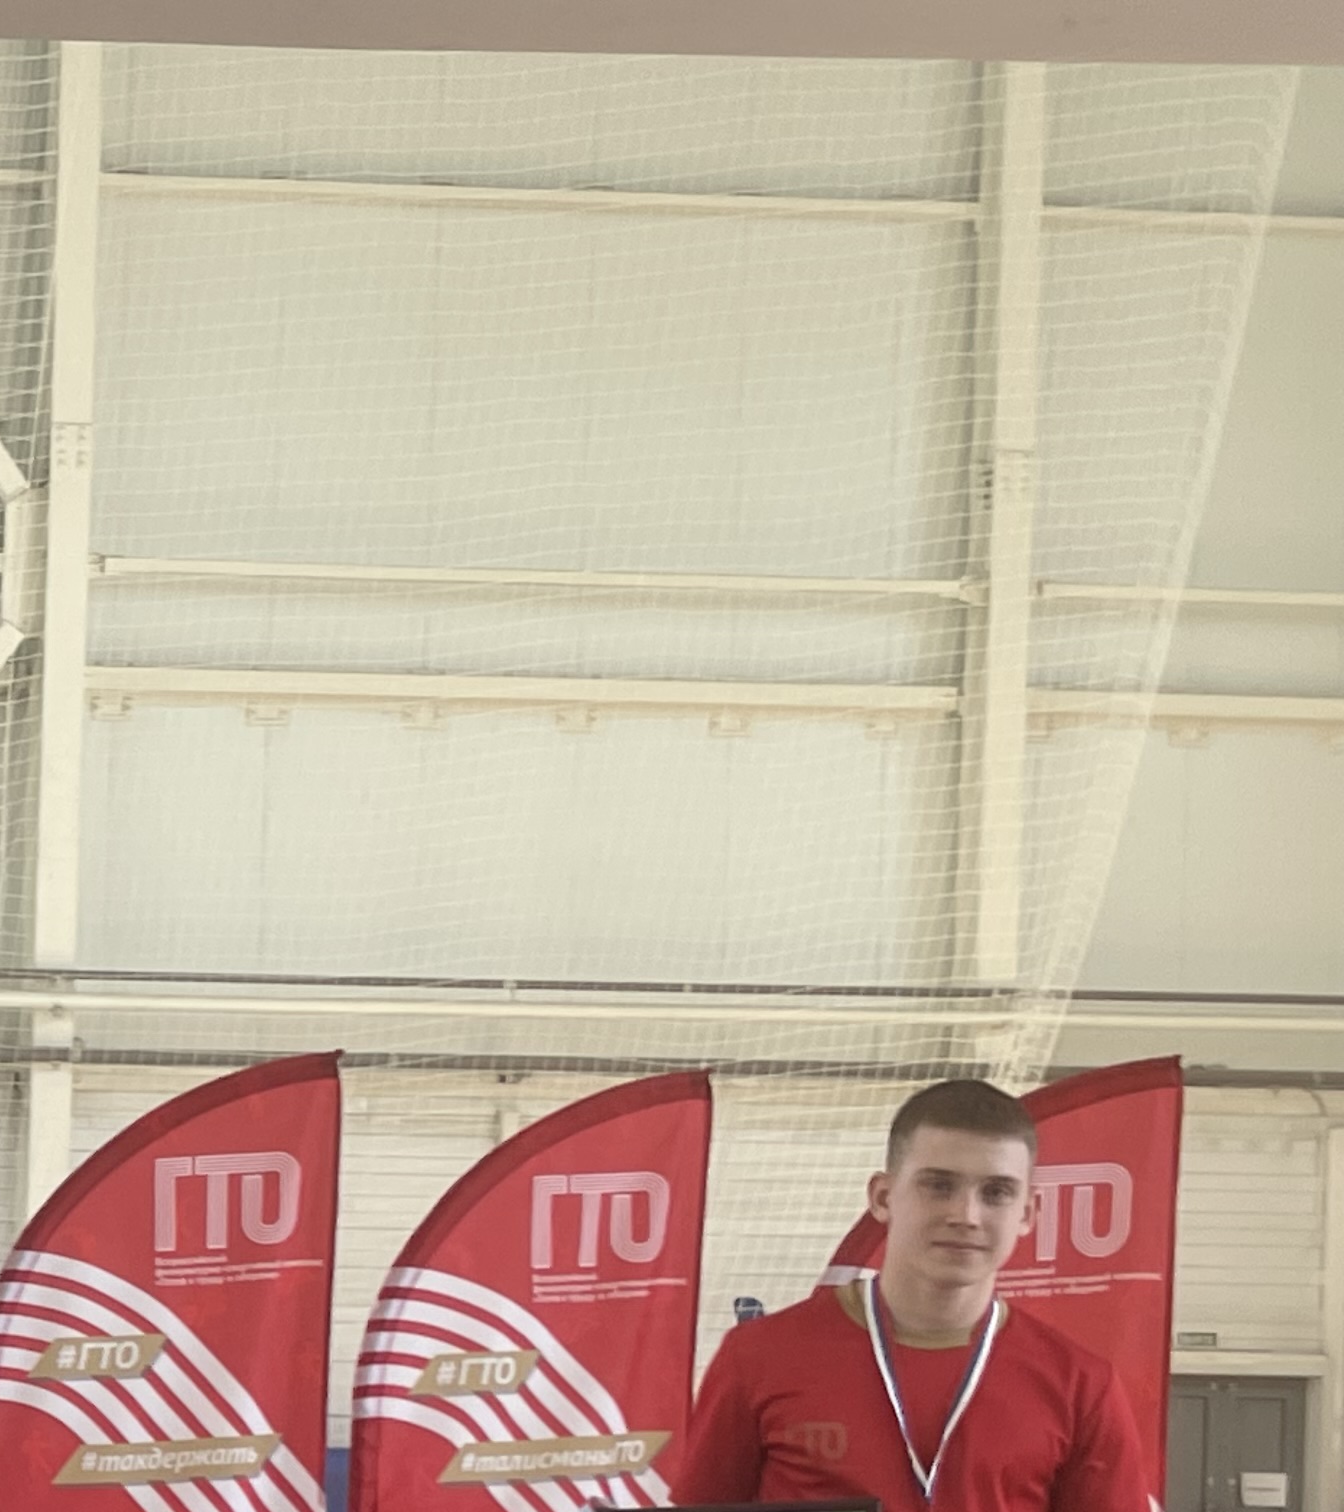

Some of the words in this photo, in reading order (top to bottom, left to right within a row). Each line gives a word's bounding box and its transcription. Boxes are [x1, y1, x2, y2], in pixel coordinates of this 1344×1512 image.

[154, 1151, 302, 1252] ГТО
[1031, 1161, 1134, 1262] ТО
[530, 1170, 671, 1269] ГТО
[56, 1341, 140, 1371] #ГТО
[435, 1356, 517, 1386] #ГТО
[80, 1443, 260, 1473] #такдержать
[460, 1439, 646, 1471] #талисманыГТО
